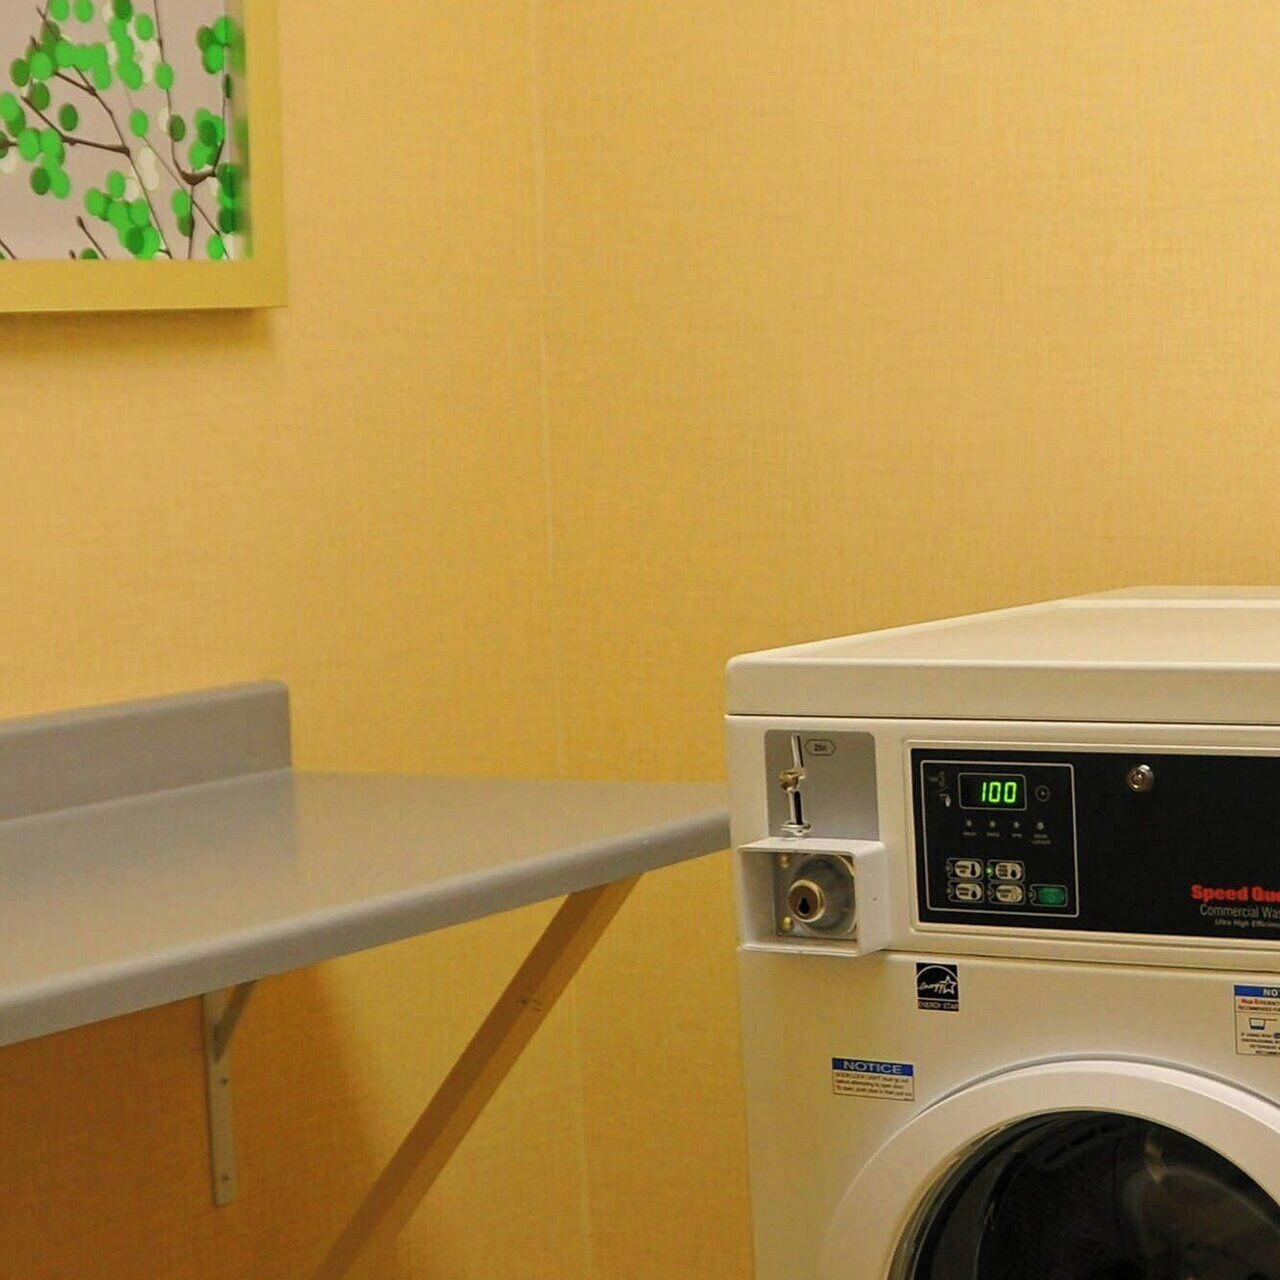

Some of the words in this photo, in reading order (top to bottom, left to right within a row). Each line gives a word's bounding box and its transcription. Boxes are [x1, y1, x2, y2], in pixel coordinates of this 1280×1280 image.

[982, 782, 1017, 803] 100
[1191, 884, 1249, 903] Speed
[1200, 904, 1259, 918] Commercial
[843, 1061, 903, 1074] NOTICE
